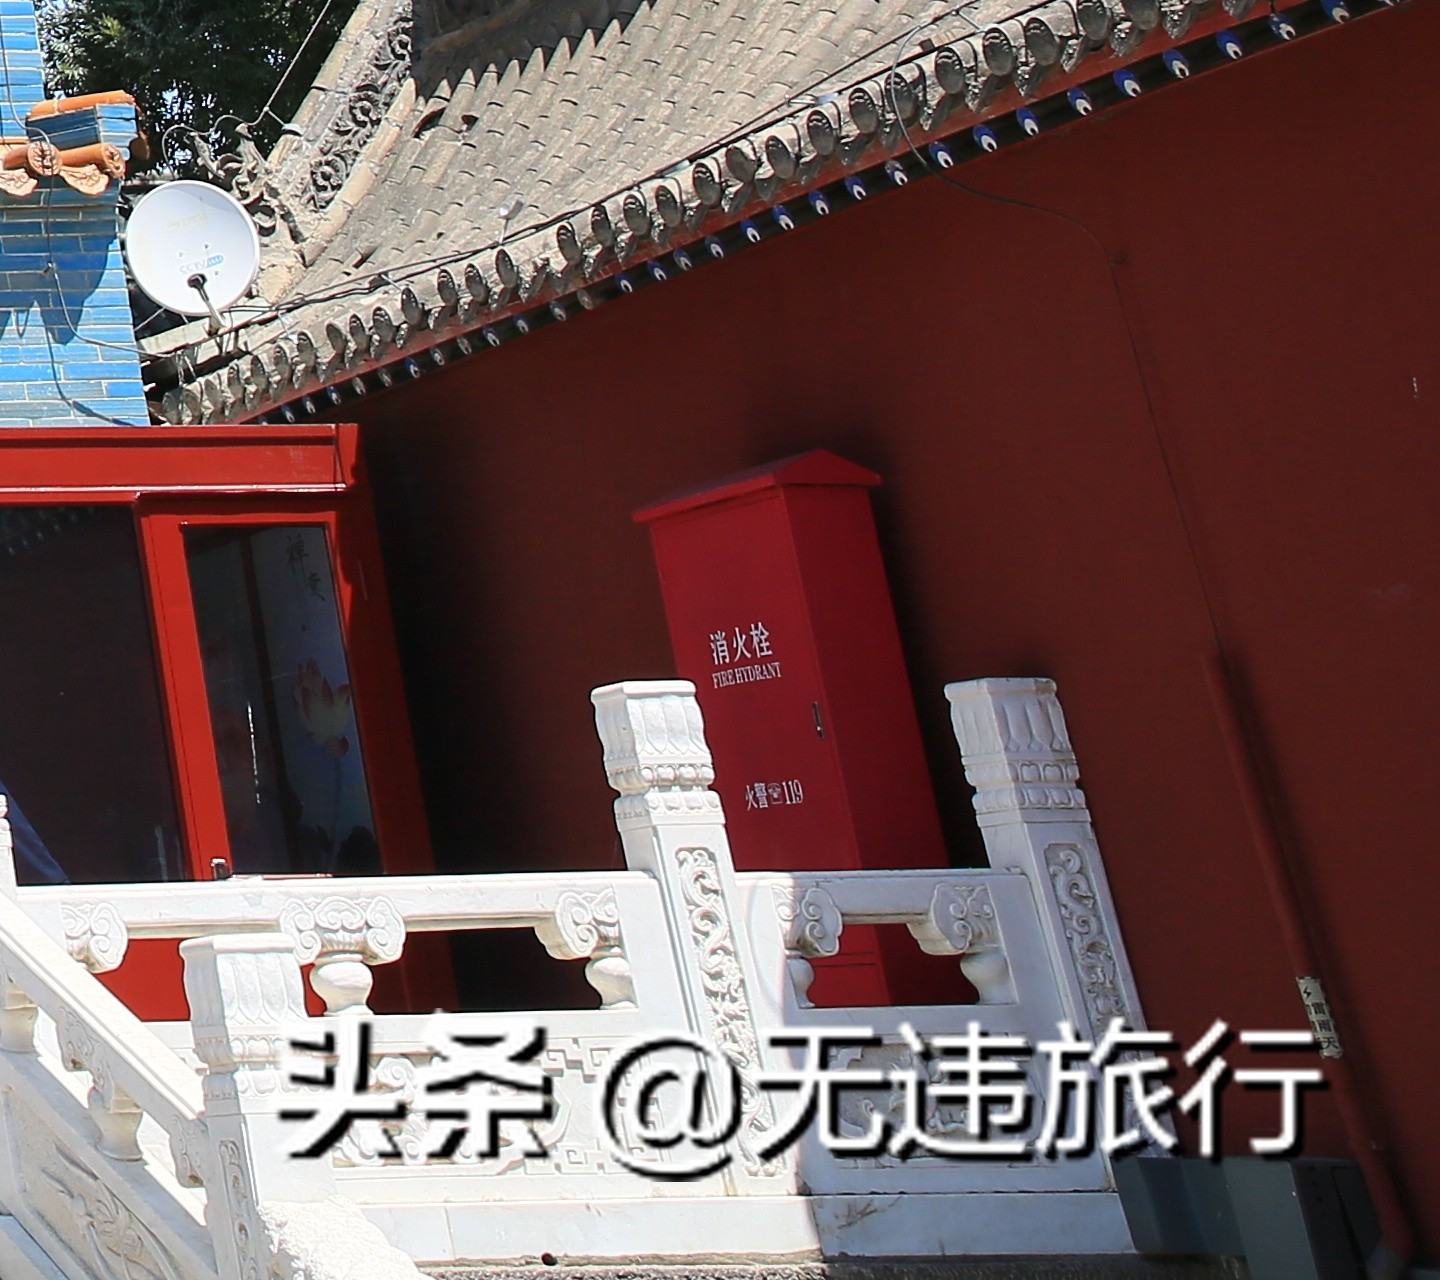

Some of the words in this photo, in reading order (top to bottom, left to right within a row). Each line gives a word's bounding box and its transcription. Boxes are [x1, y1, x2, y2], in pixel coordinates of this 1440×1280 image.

[709, 621, 773, 666] 消火栓
[711, 668, 736, 689] FIRE
[734, 661, 782, 684] HYDRANT
[745, 782, 769, 812] 火警
[782, 779, 804, 805] 119
